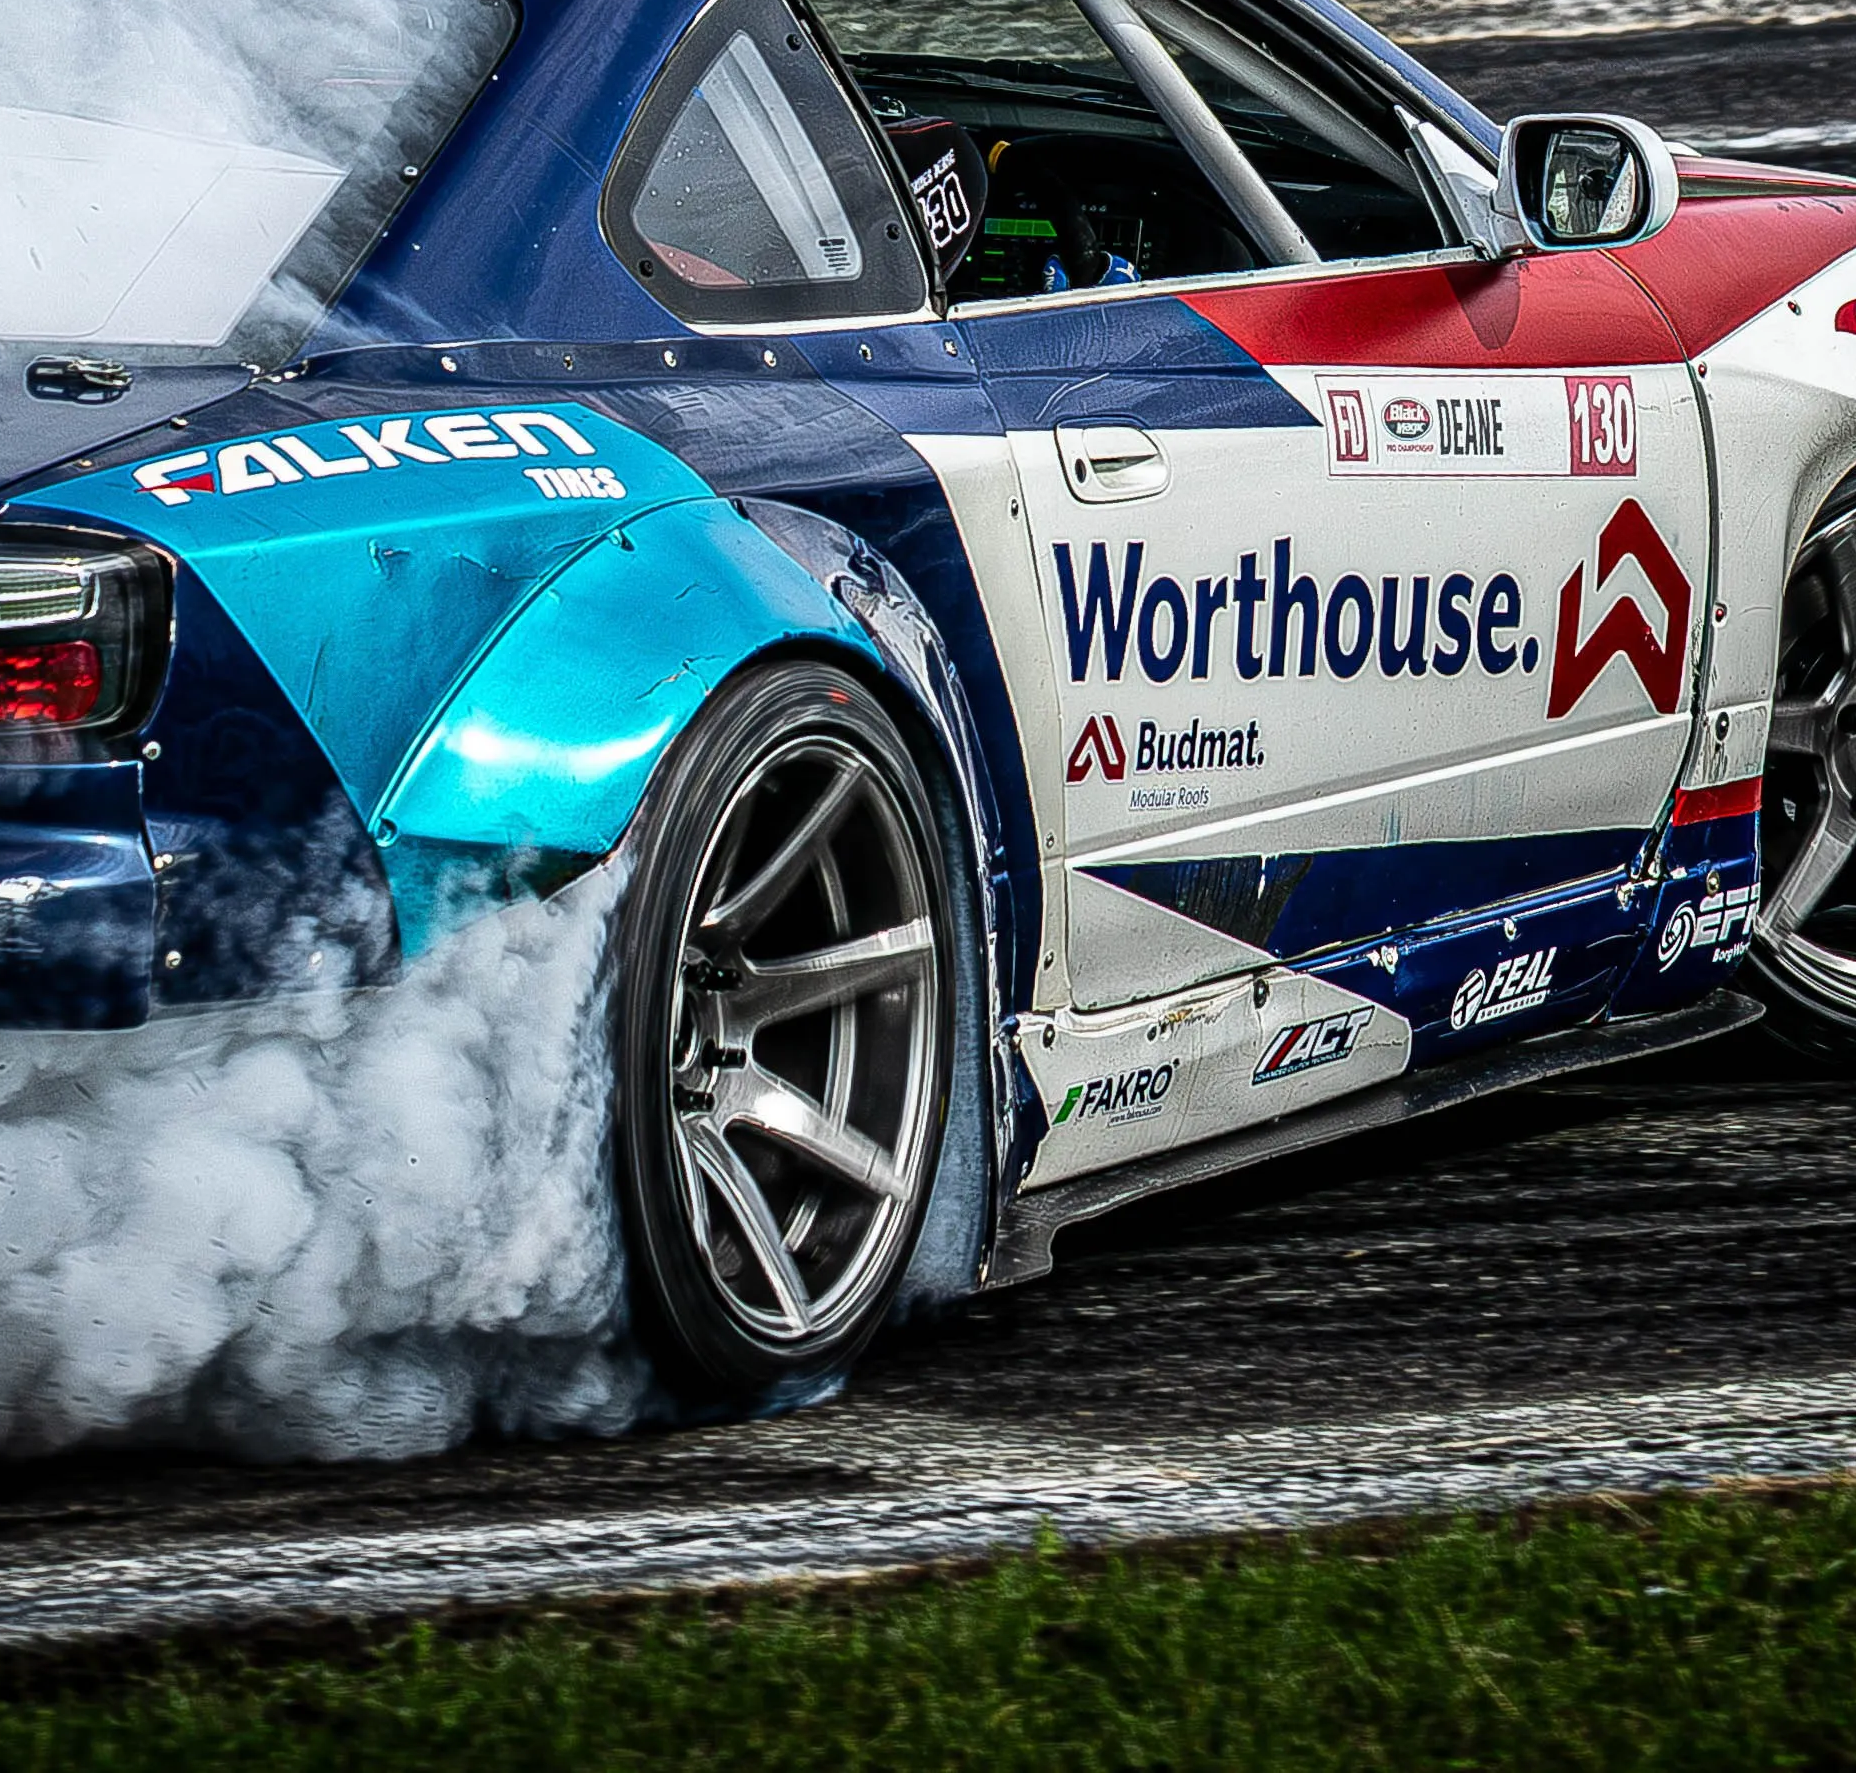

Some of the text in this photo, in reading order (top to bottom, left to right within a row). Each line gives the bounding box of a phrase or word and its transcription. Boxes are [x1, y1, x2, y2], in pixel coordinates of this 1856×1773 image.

[1389, 403, 1425, 422] Black
[1436, 399, 1505, 456] DEANE
[1572, 382, 1637, 466] 130
[132, 411, 597, 507] FALKEN
[523, 466, 627, 501] TIRES
[1051, 536, 1541, 684] Worthouse.
[1135, 718, 1266, 771] Budmat.
[1129, 785, 1210, 808] Modular Roofs
[1483, 946, 1558, 1005] FEAL
[1279, 1006, 1374, 1068] ACT
[1078, 1064, 1174, 1119] FAKRO
